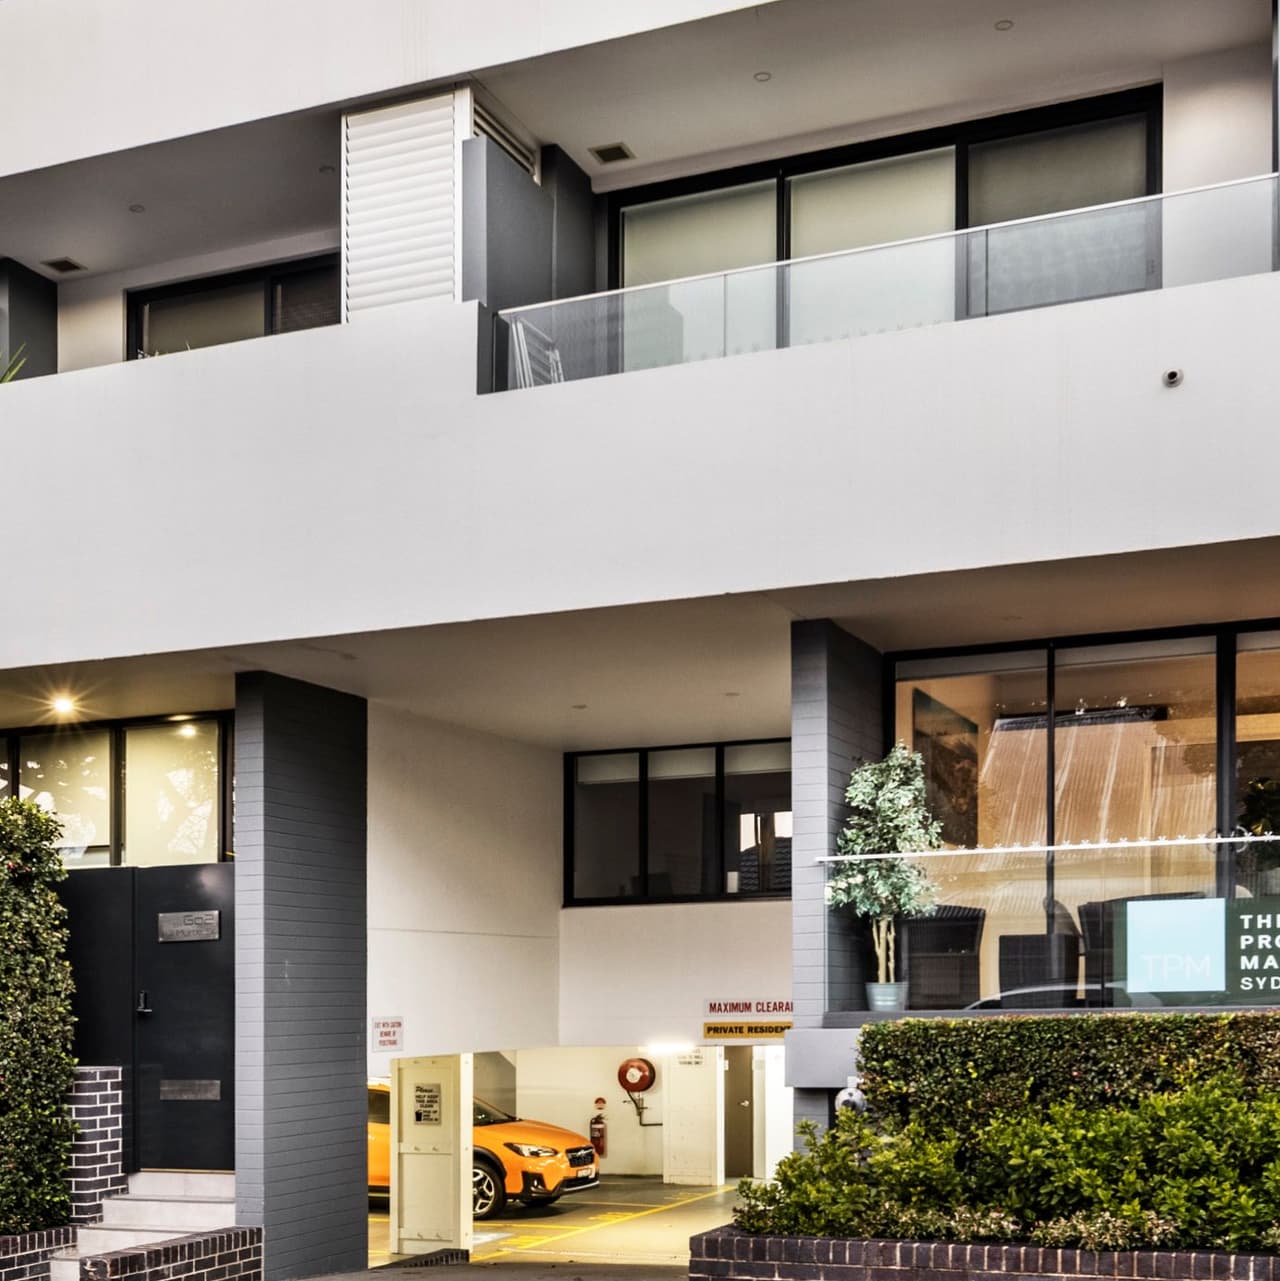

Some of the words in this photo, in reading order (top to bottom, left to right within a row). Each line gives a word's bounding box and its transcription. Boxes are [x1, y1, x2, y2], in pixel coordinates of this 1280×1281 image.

[1141, 952, 1211, 983] TPM
[709, 1002, 752, 1013] MAXIMUM
[755, 1002, 794, 1013] CLEARA
[706, 1025, 744, 1034] PRIVATE
